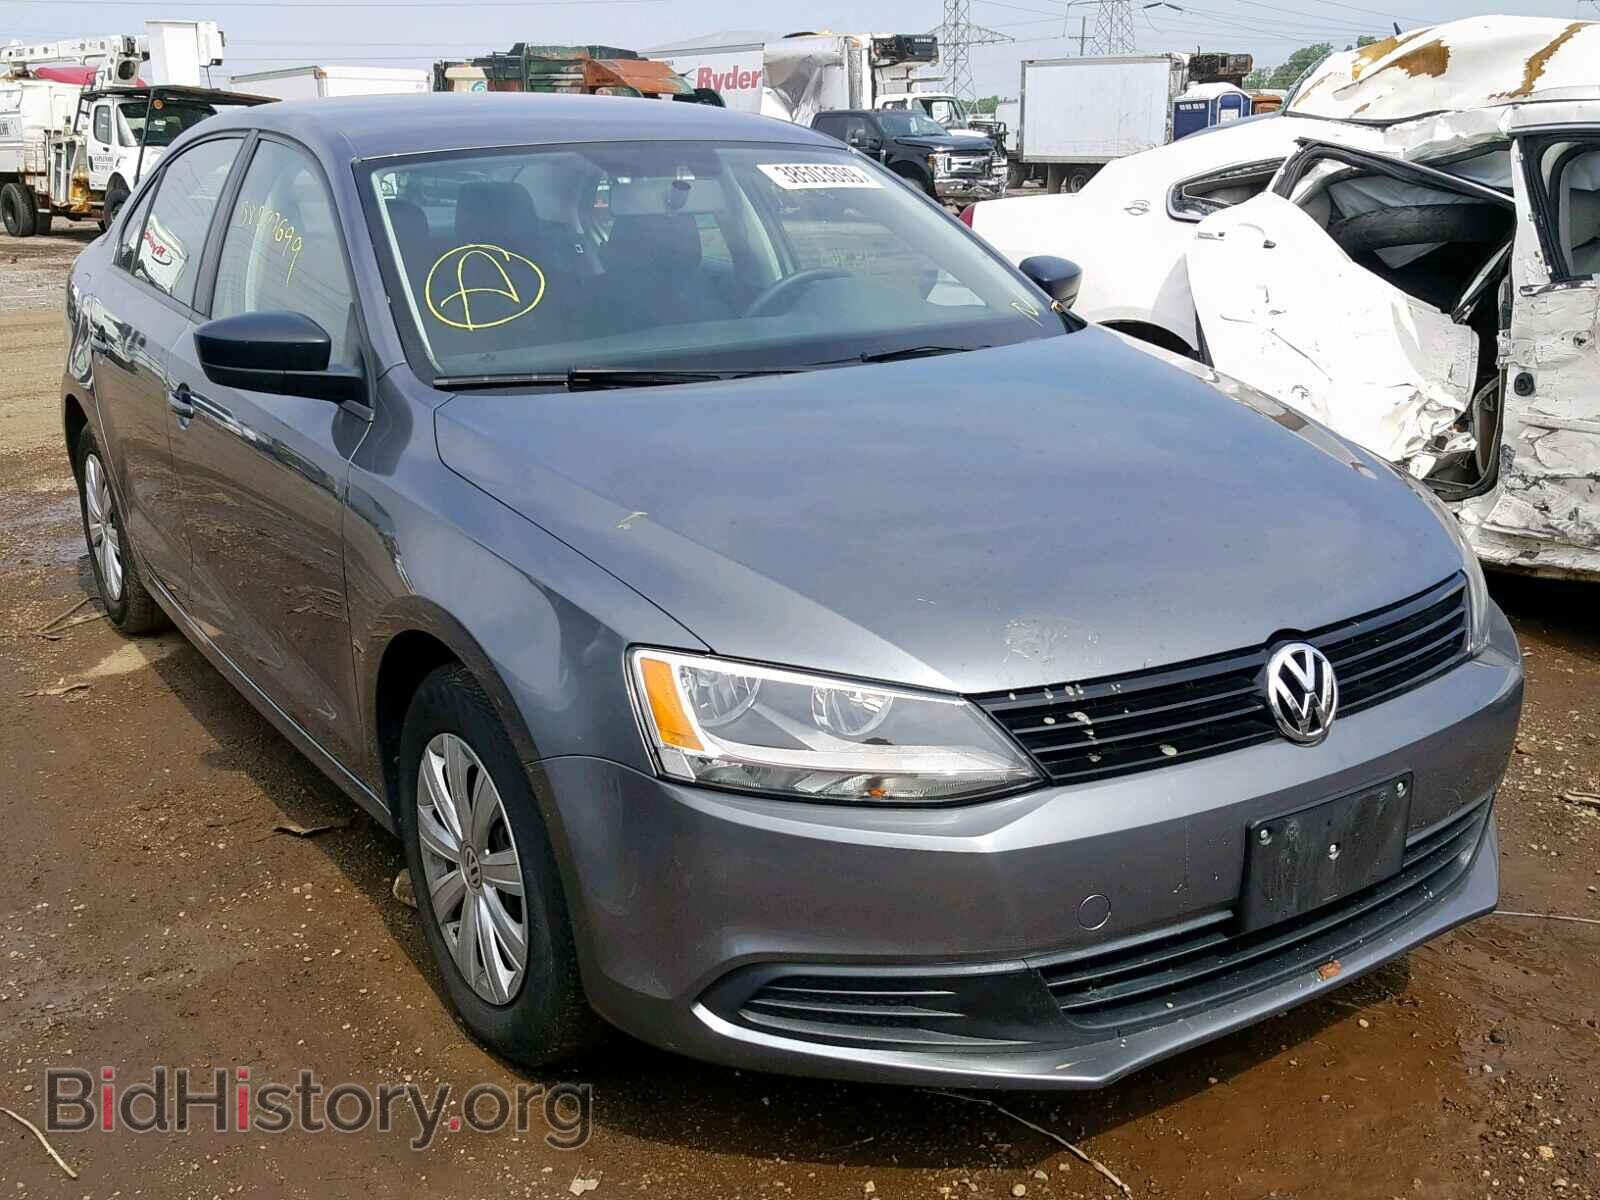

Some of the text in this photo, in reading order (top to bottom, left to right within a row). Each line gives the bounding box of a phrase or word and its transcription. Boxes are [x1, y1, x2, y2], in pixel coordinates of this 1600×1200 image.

[697, 65, 761, 92] Ryder
[440, 249, 520, 331] A
[1269, 644, 1336, 741] VW
